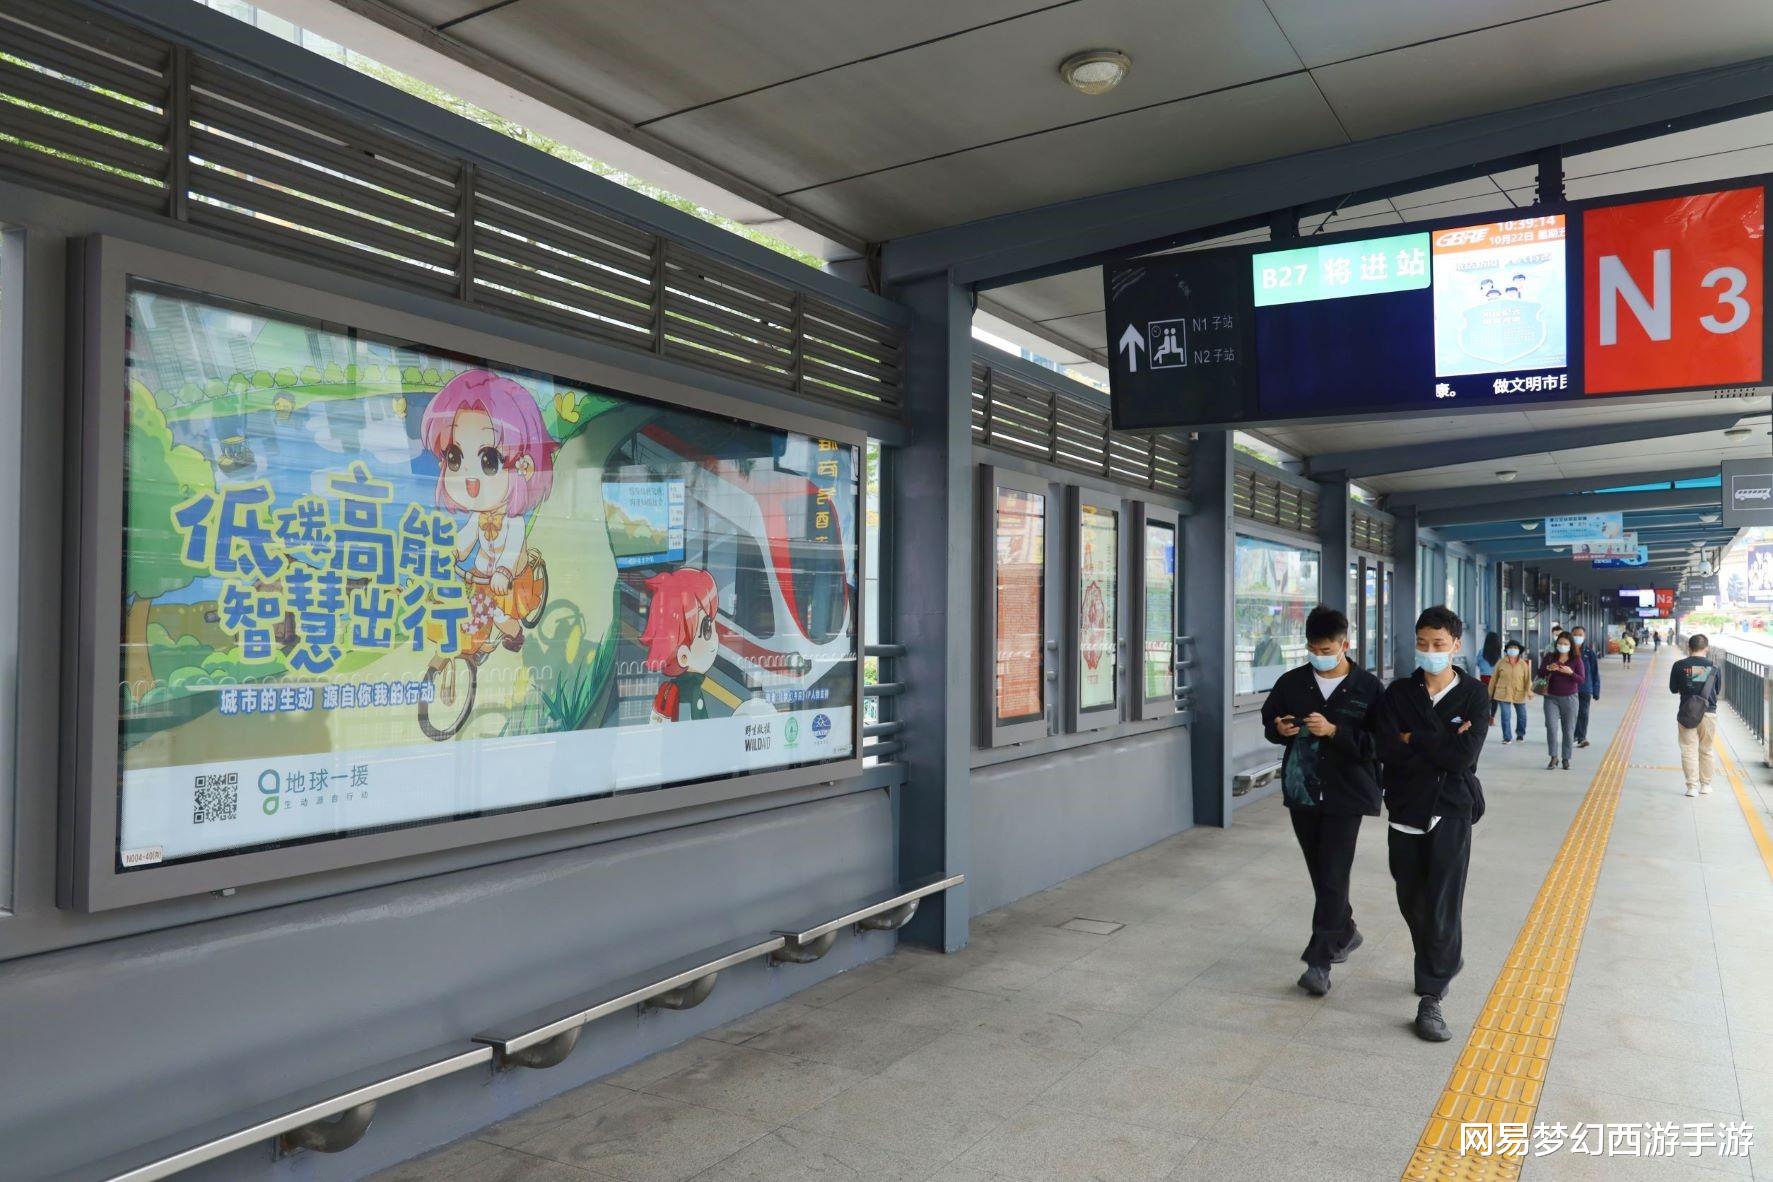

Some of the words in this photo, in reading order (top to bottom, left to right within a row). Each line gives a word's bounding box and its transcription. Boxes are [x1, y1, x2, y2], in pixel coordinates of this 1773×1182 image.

[1262, 264, 1308, 289] B27
[1324, 247, 1425, 287] 将进站
[1192, 317, 1207, 332] N1
[1211, 315, 1233, 330] 子站
[1194, 350, 1211, 364] N2
[1213, 347, 1235, 363] 子站
[174, 463, 455, 586] 低碳高能
[1656, 594, 1673, 605] N2
[222, 567, 470, 675] 智慧出行
[220, 685, 313, 714] 城市的生动
[323, 682, 435, 709] 源自你我的行动
[285, 764, 369, 794] 地球一援
[284, 791, 369, 810] 生动源自行动
